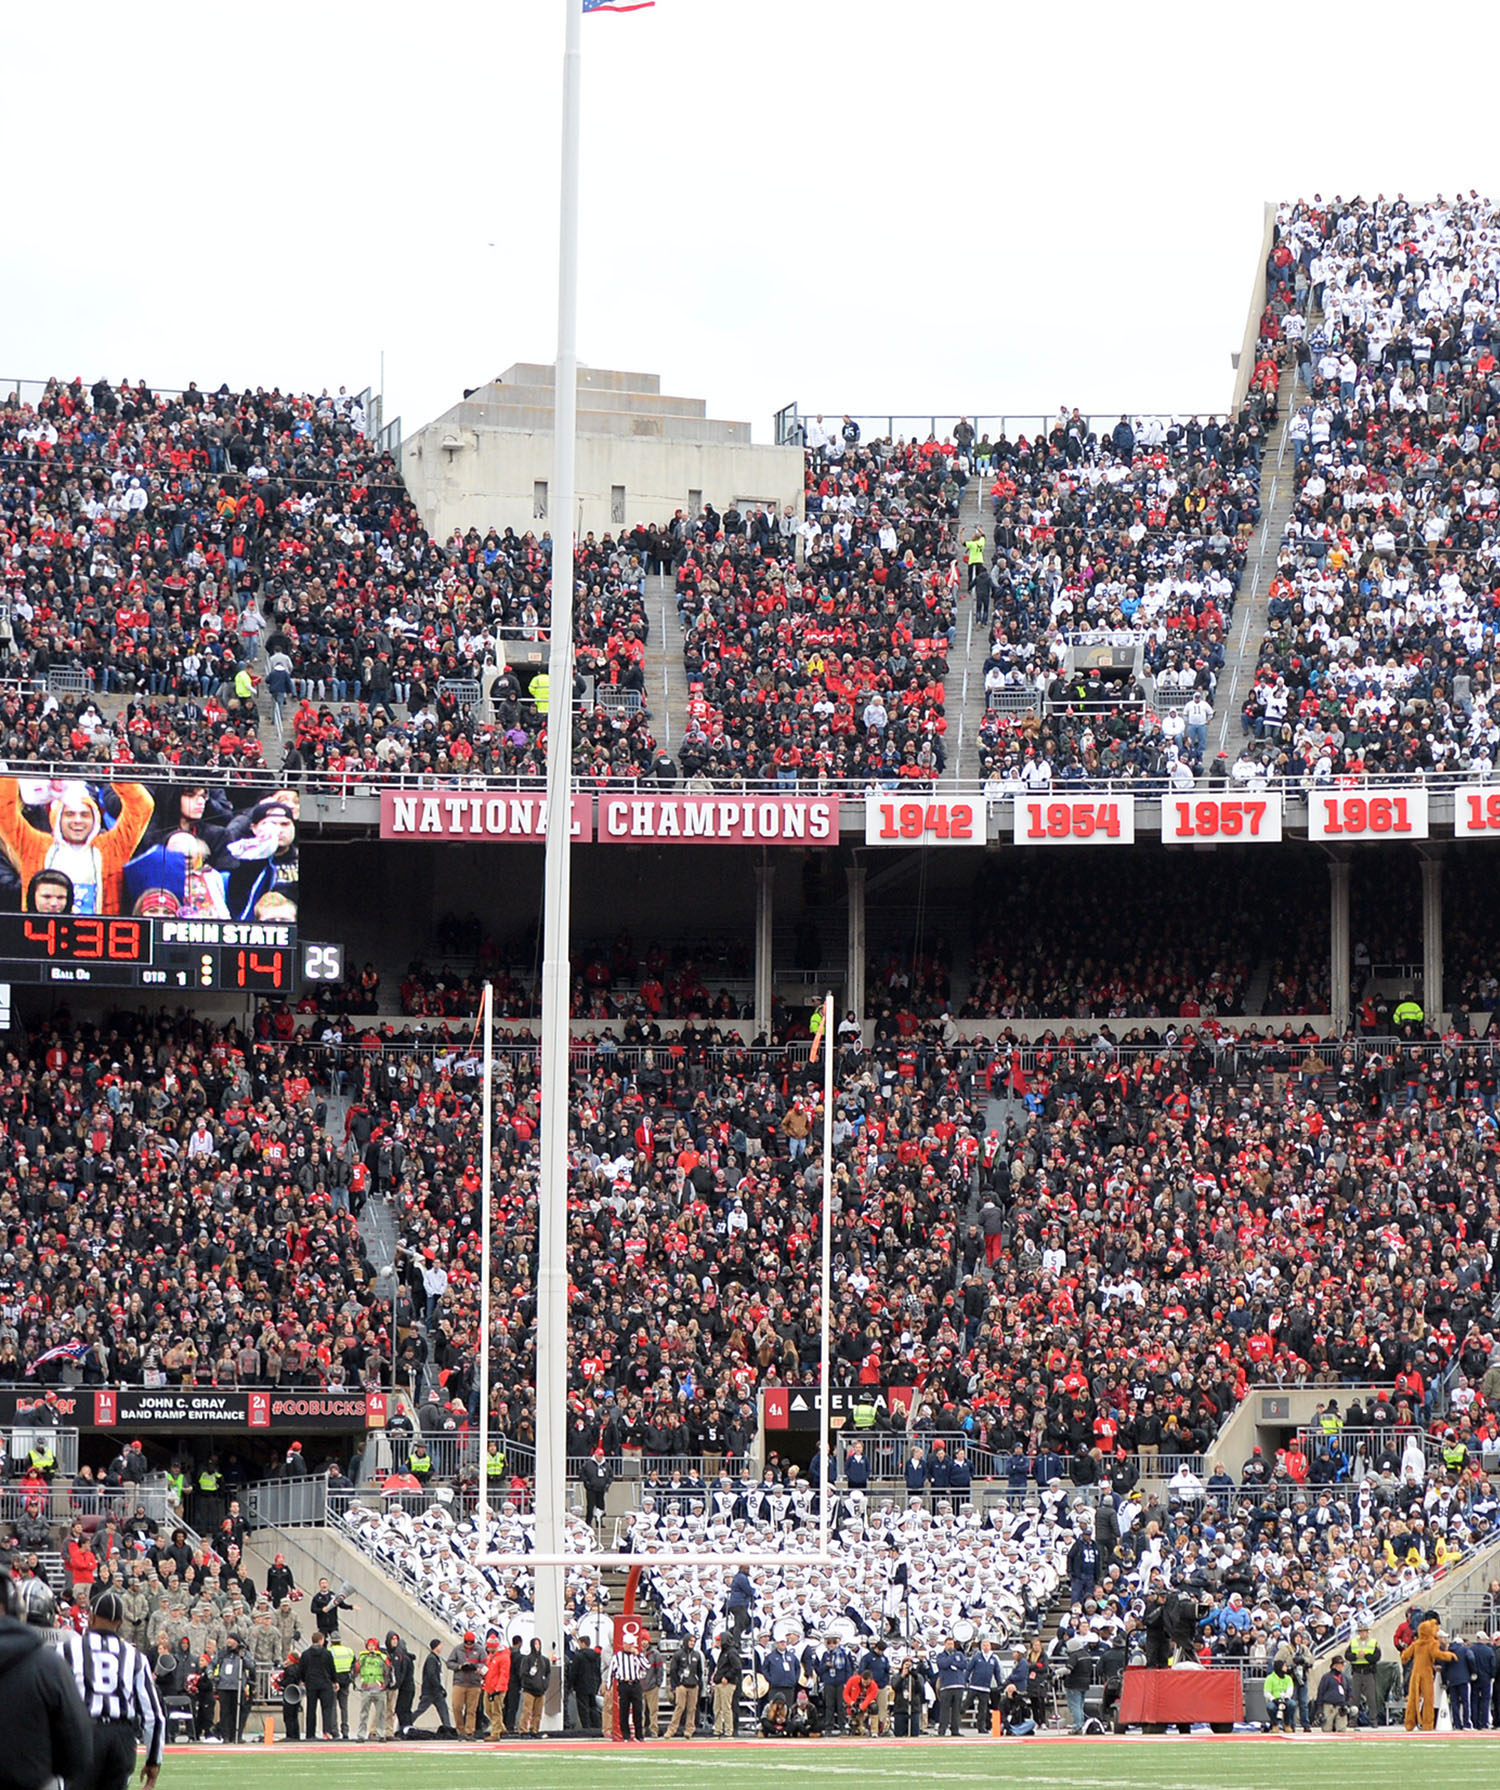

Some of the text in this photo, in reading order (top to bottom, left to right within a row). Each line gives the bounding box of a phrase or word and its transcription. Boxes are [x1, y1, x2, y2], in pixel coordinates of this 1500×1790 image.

[607, 800, 831, 838] CHAMPIONS
[879, 803, 973, 838] 1942
[1027, 803, 1121, 838] 1954
[1175, 801, 1267, 836] 1957
[1323, 797, 1412, 833] 1961
[24, 919, 140, 959] 4:38
[162, 922, 289, 946] PENN STATE
[237, 950, 282, 988] 14
[305, 946, 340, 980] 25
[176, 971, 187, 986] 1
[354, 1170, 360, 1179] 5
[1050, 1257, 1057, 1265] 5
[584, 1364, 596, 1374] 97
[99, 1394, 112, 1407] 1A
[1134, 1387, 1146, 1400] 97
[138, 1398, 226, 1410] JOHN C. GRAY
[252, 1395, 266, 1409] 2A
[271, 1399, 366, 1416] #GOBUCKS
[369, 1396, 383, 1410] 4A
[768, 1403, 783, 1416] 4A
[121, 1410, 245, 1420] BAND RAMP ENTRANCE
[709, 1427, 717, 1440] 5
[92, 1652, 119, 1694] B
